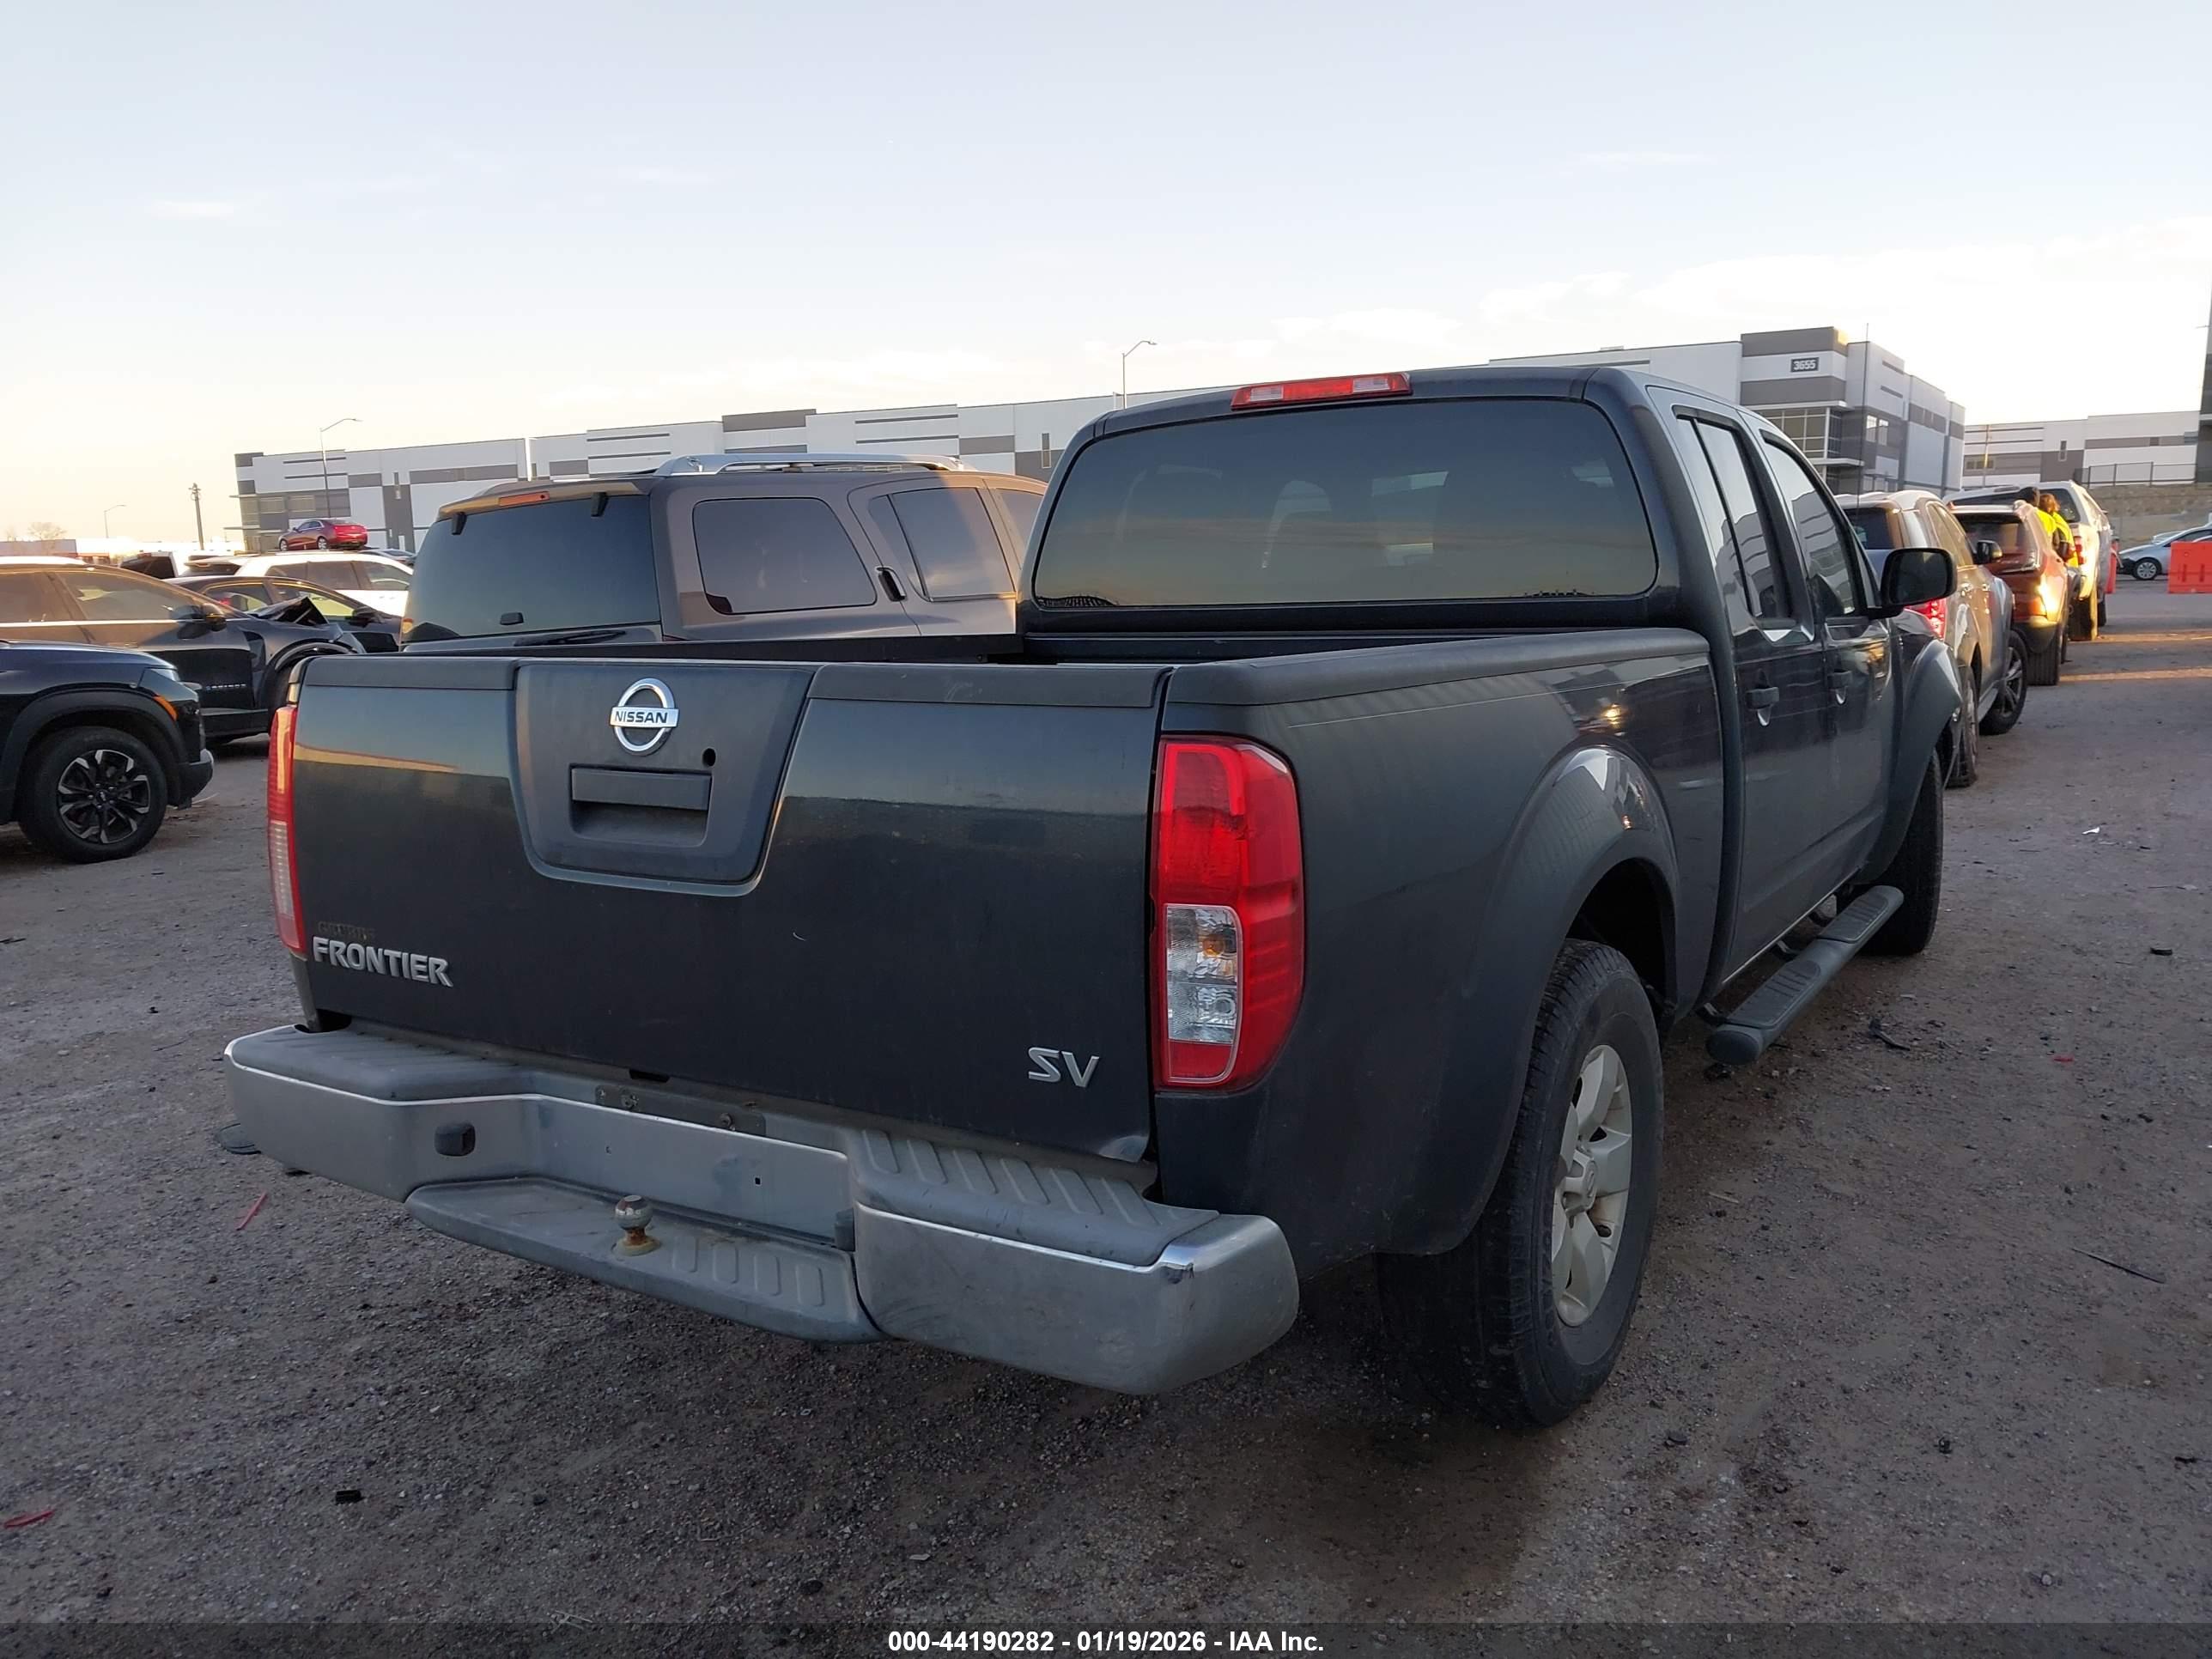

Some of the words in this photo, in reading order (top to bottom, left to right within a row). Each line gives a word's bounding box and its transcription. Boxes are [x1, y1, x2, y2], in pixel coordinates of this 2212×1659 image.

[1793, 360, 1816, 370] 3655
[615, 710, 668, 724] NISSAN
[313, 936, 453, 988] FRONTIER
[1028, 1047, 1100, 1087] SV
